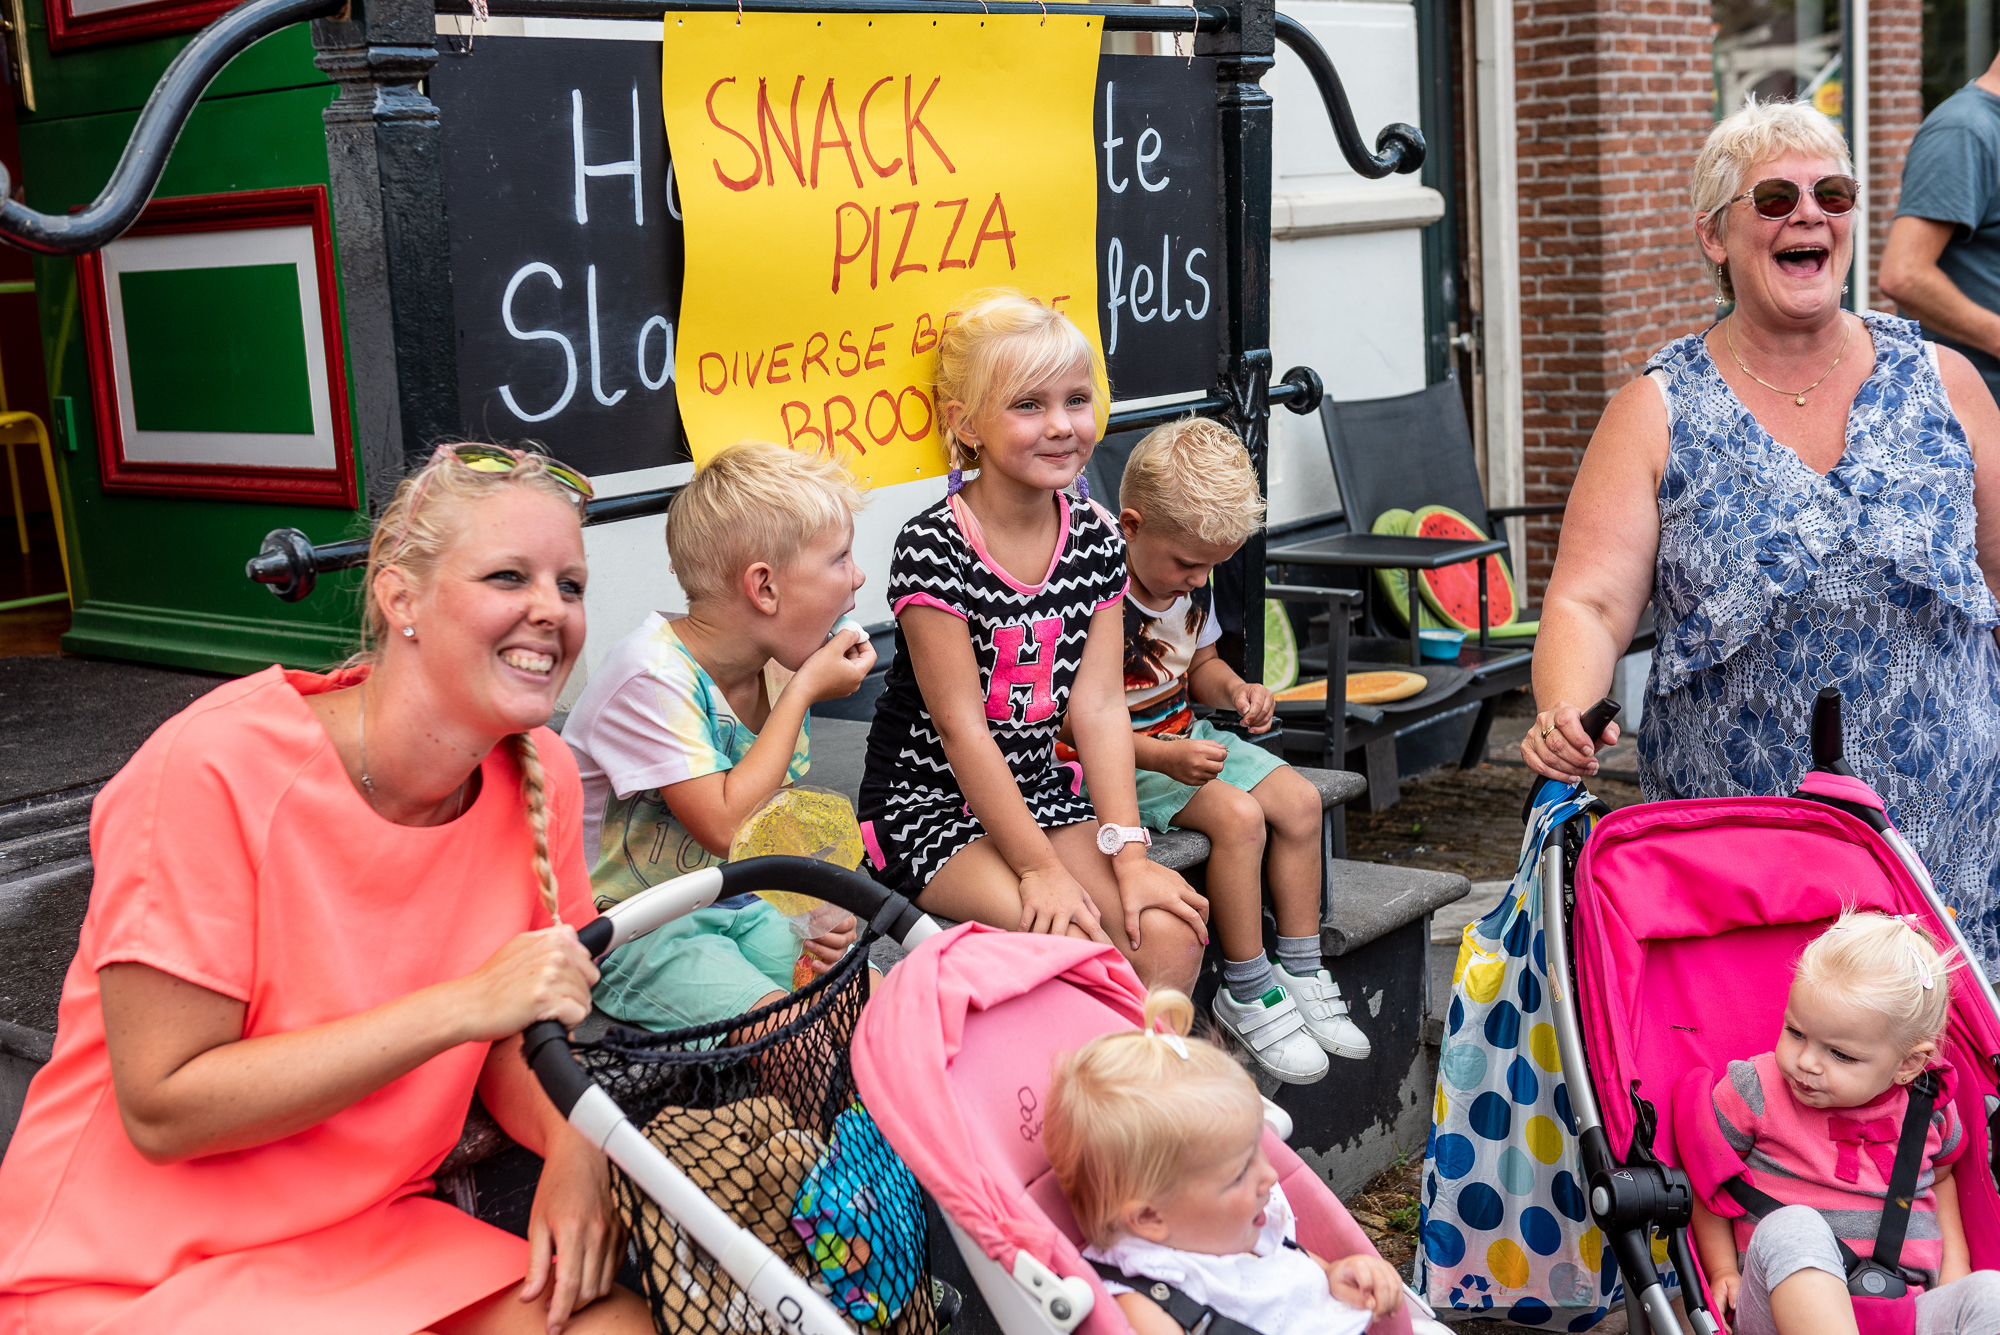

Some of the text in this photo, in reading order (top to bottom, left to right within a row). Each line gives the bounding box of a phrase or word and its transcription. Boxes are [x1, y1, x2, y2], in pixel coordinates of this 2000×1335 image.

[705, 74, 956, 191] SNACK
[831, 192, 1016, 294] PIZZA
[698, 322, 895, 395] DIVERSE
[983, 616, 1064, 729] H
